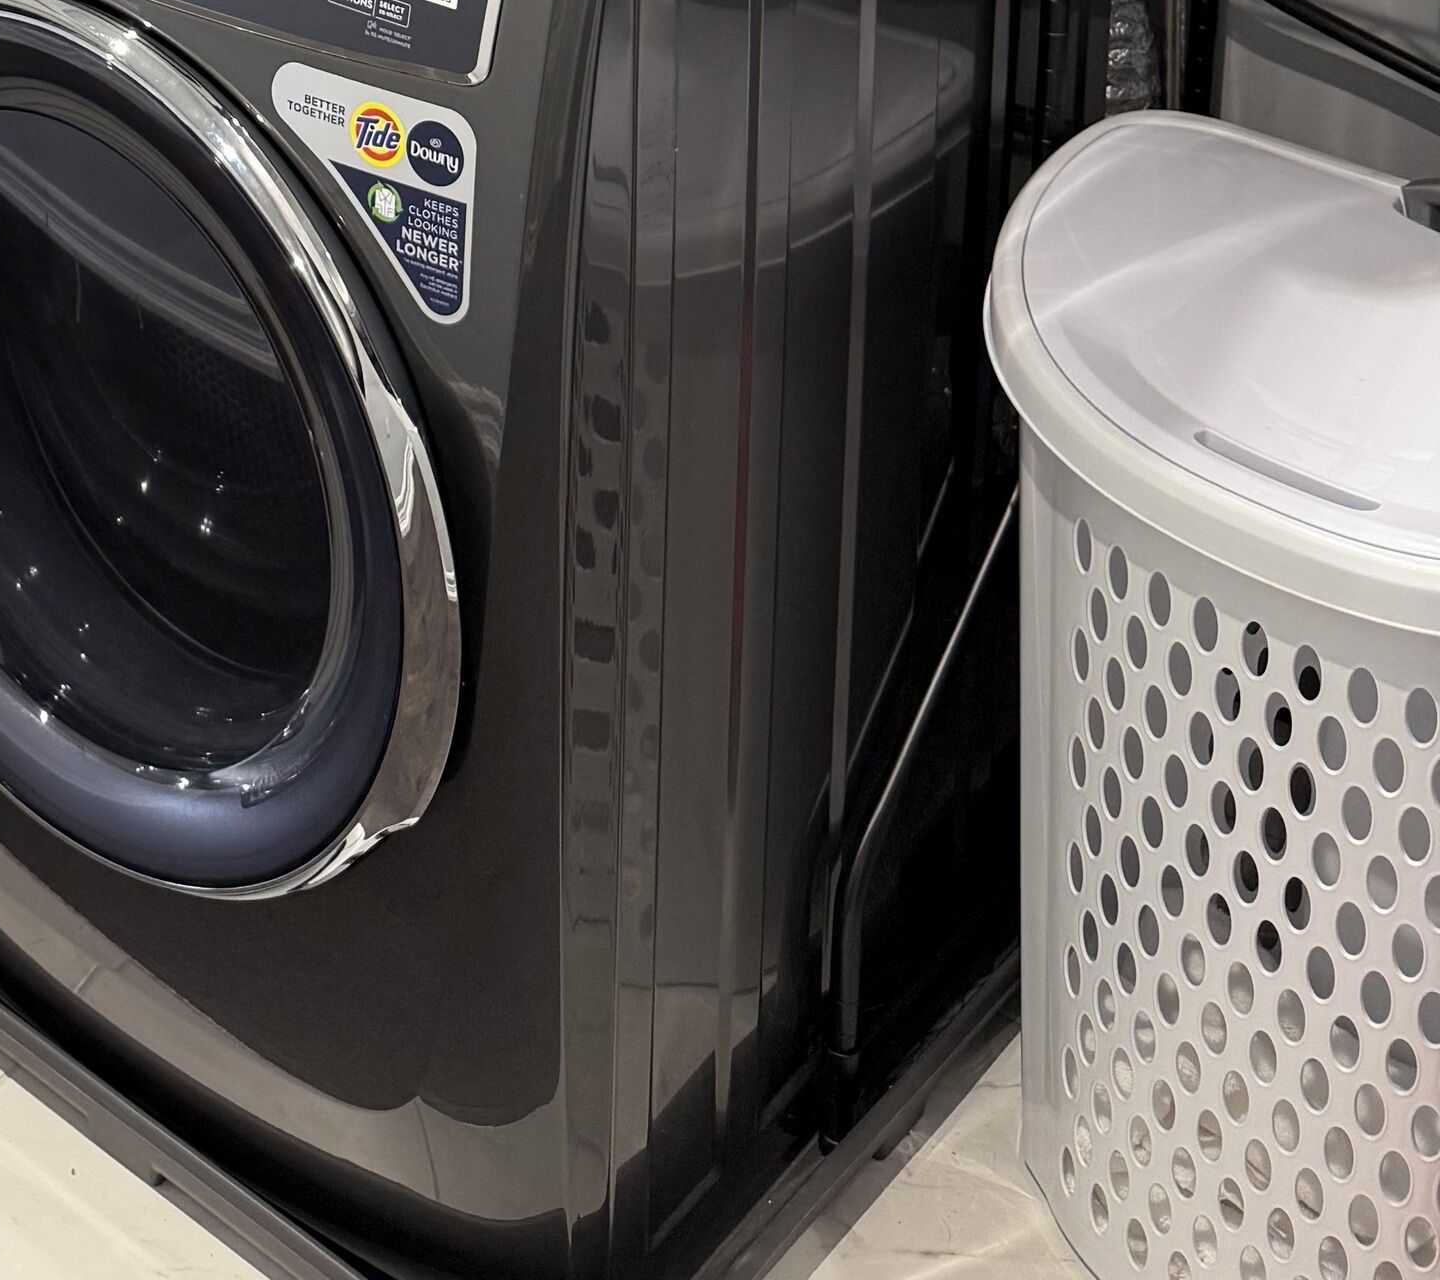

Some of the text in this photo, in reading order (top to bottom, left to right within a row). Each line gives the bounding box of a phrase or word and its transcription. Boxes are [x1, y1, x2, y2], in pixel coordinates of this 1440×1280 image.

[379, 0, 405, 14] SELECT
[287, 99, 345, 127] TOGETHER
[303, 94, 346, 117] BETTER
[355, 116, 402, 151] Tide
[410, 140, 460, 173] Downy
[409, 204, 459, 229] CLOTHES
[423, 197, 460, 217] KEEPS
[408, 216, 458, 240] LOOKING
[401, 225, 459, 257] NEWER
